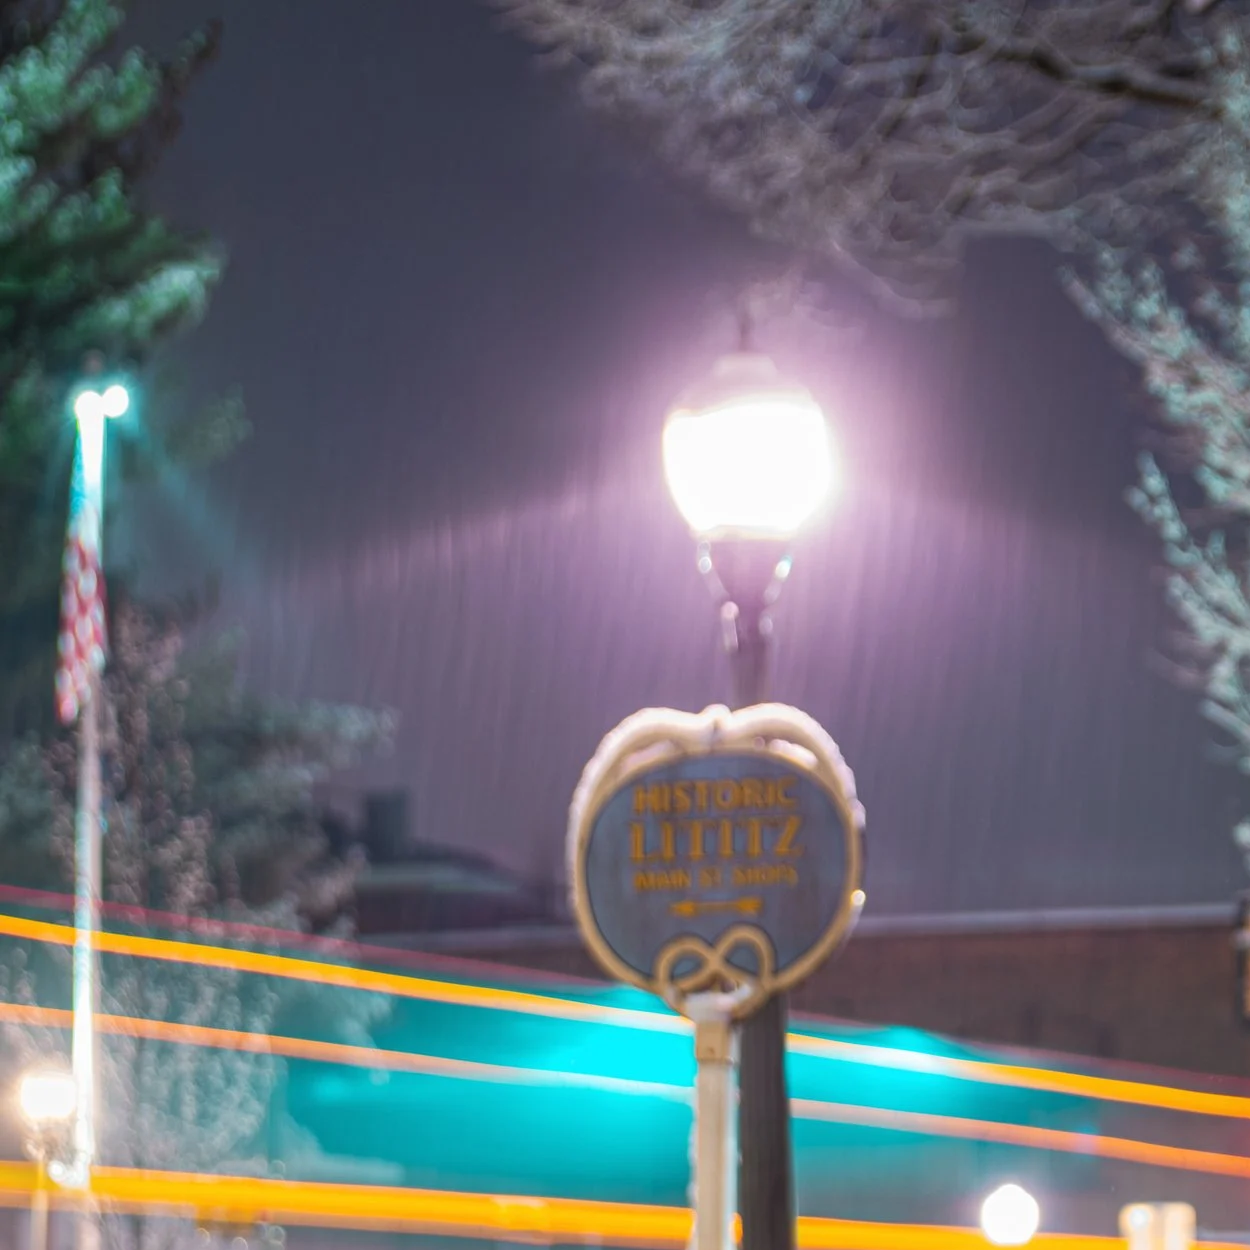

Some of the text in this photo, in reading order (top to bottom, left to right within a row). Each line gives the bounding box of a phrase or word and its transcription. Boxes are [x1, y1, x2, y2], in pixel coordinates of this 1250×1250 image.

[634, 777, 797, 814] HISTORIC
[630, 816, 803, 861] LITITZ
[634, 870, 691, 891] MAIN
